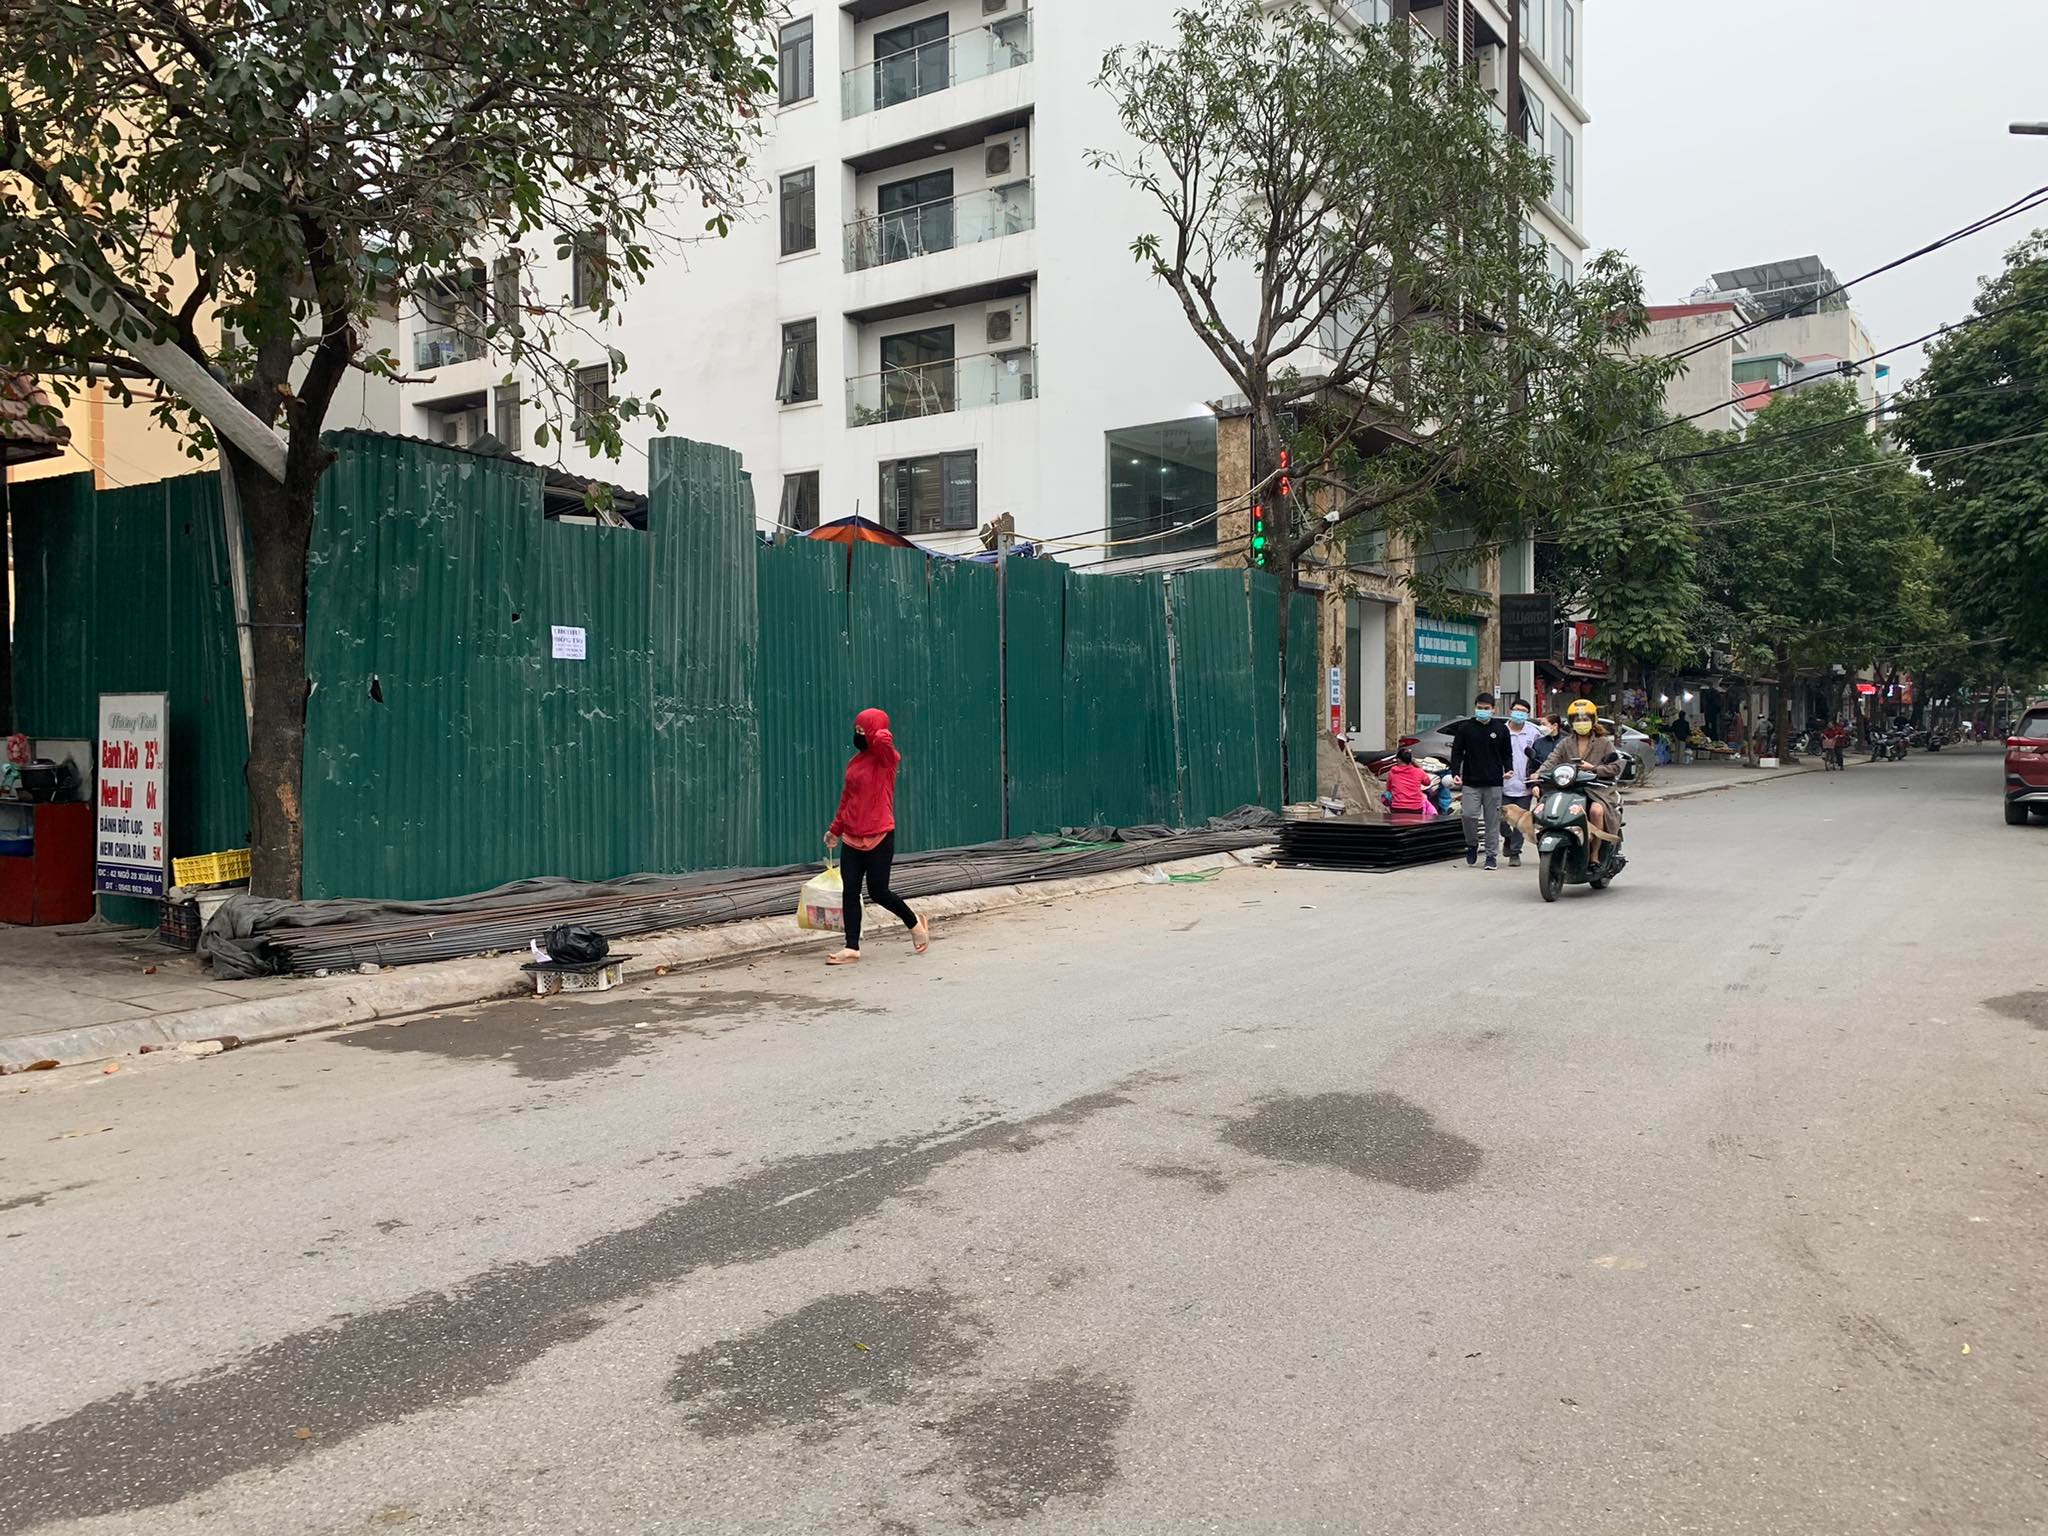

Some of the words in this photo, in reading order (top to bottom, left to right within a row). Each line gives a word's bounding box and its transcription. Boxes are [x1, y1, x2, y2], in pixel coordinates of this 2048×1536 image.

[102, 740, 121, 768] Bánh
[123, 740, 138, 769] Xèo
[101, 779, 119, 807] Nem
[120, 780, 132, 813] Lụi
[100, 815, 117, 832] BÁNH
[118, 816, 130, 837] BỘT
[131, 819, 143, 838] LỌC
[100, 841, 113, 856] NEM
[114, 842, 131, 858] CHUA
[132, 842, 146, 859] RÁN
